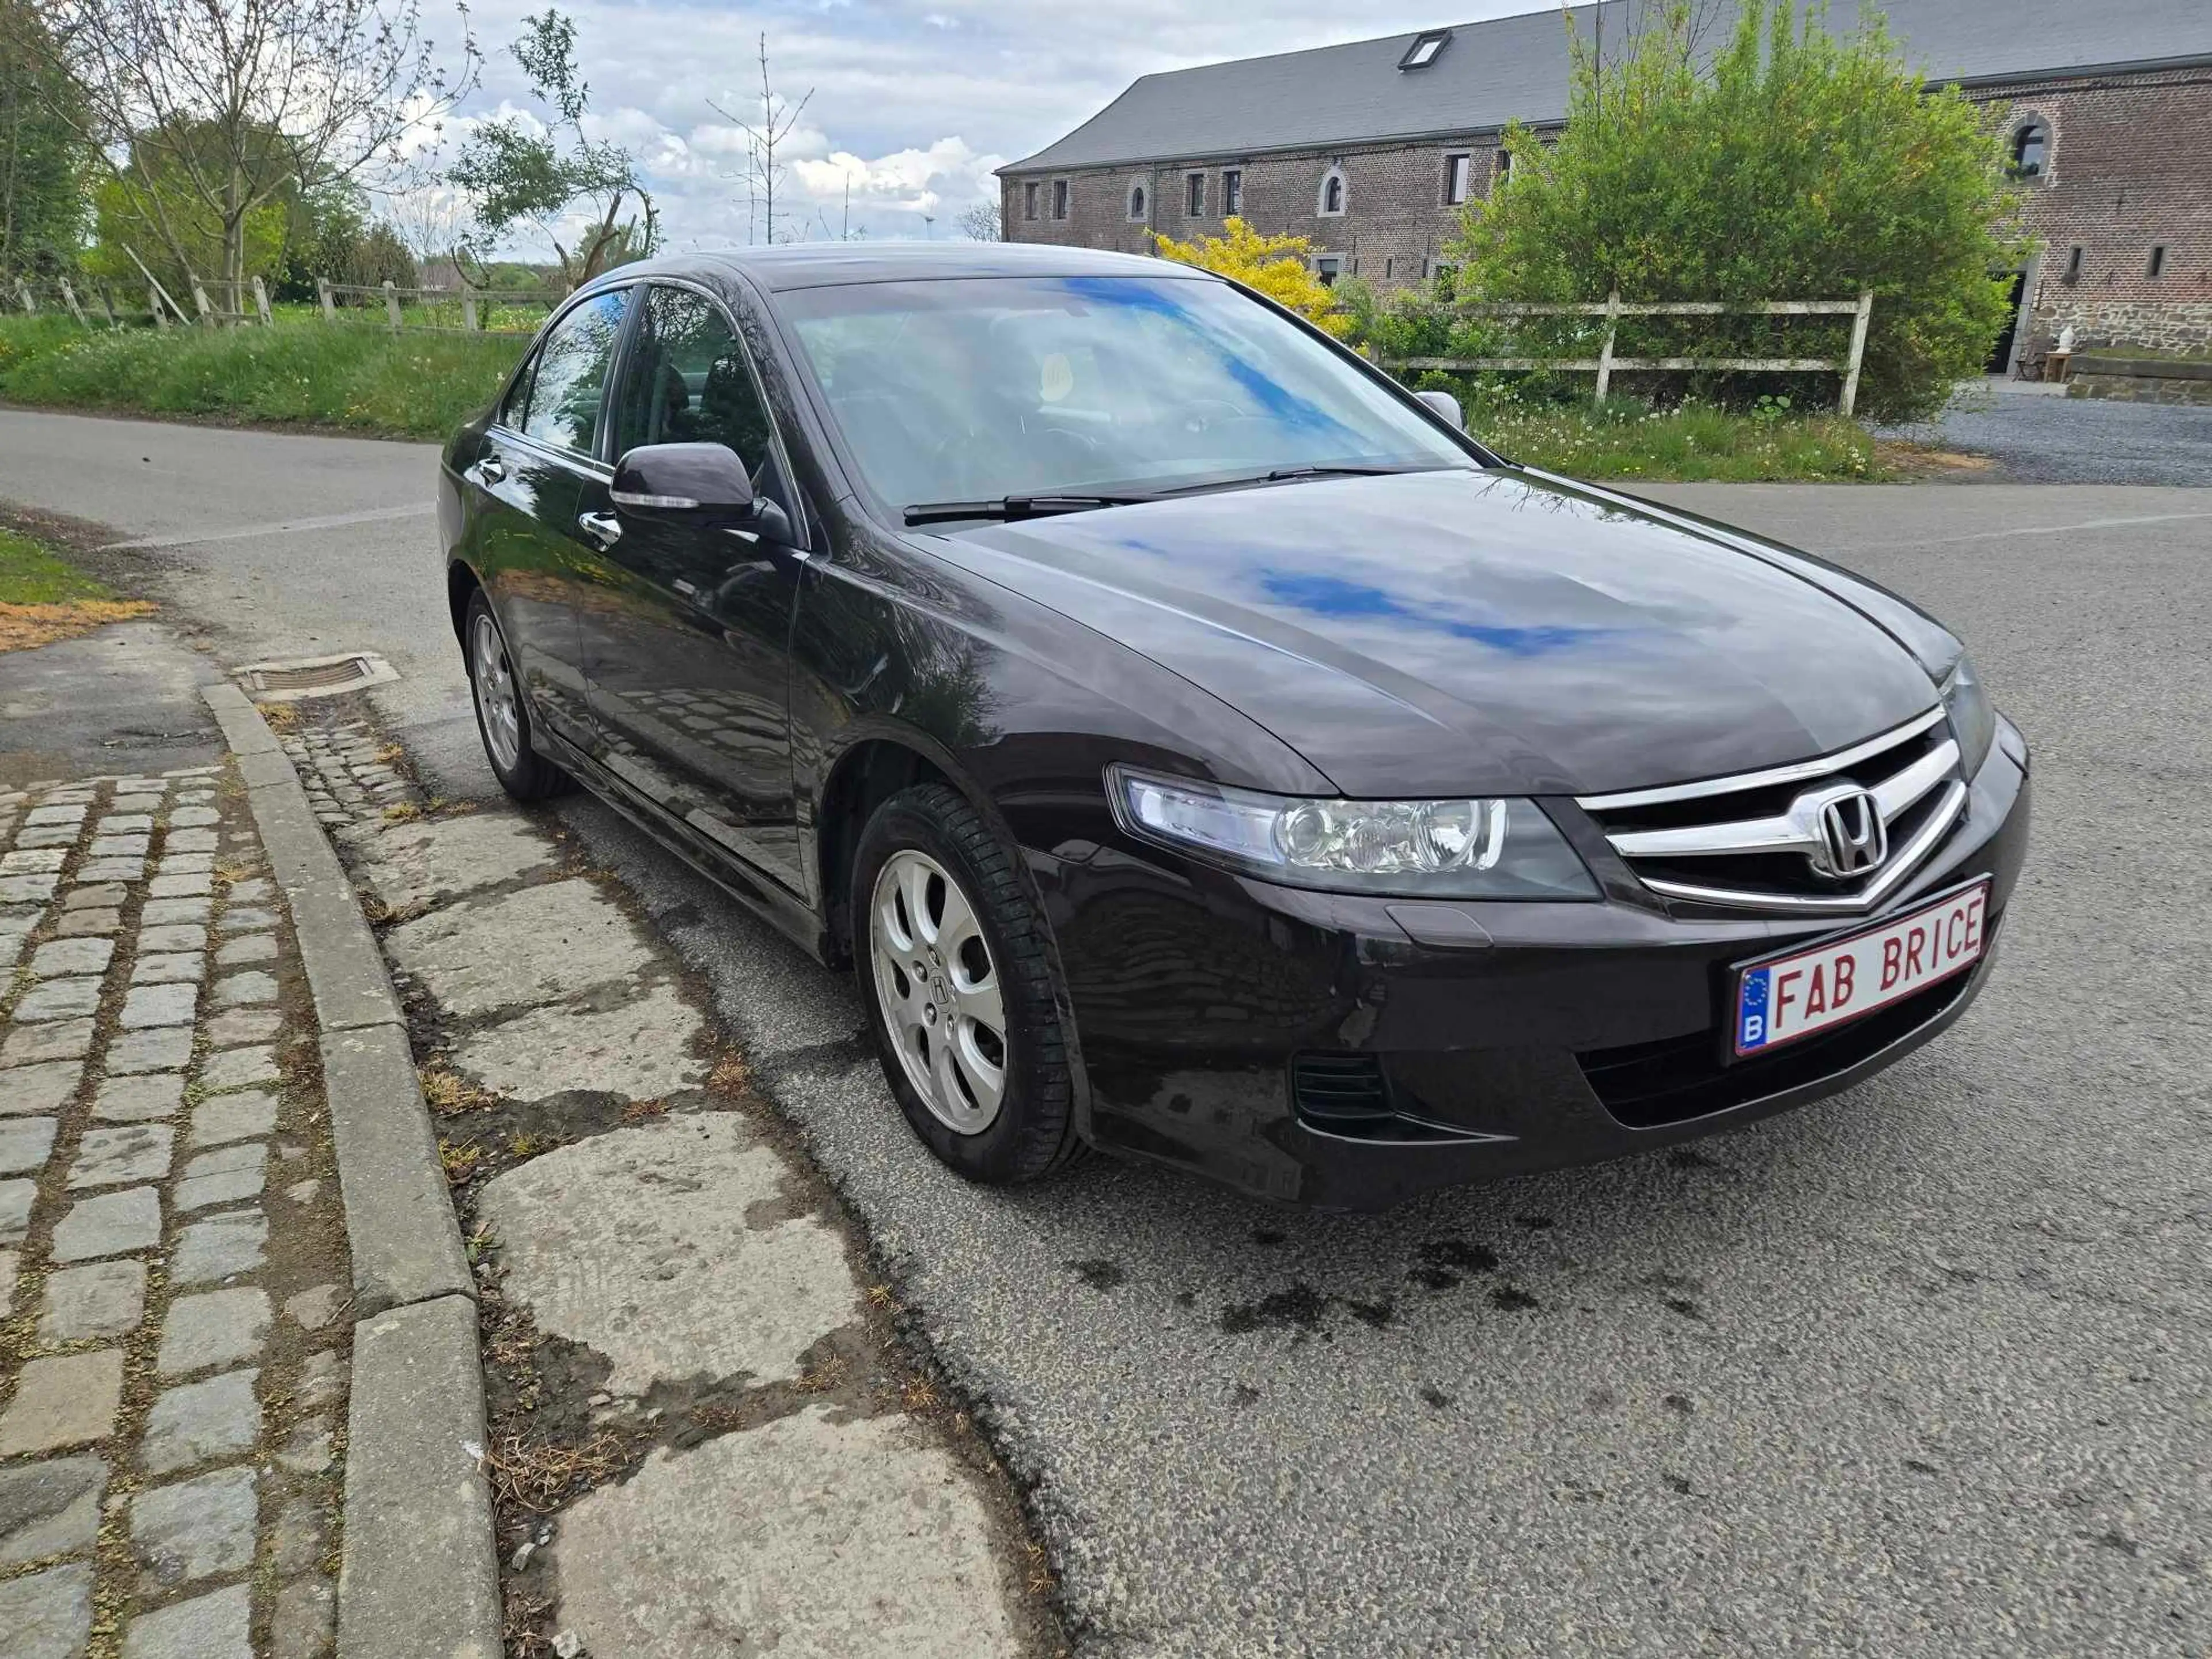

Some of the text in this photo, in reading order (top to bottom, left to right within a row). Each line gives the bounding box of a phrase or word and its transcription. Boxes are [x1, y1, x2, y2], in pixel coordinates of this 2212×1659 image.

[1775, 897, 1983, 1029] FAB BRICE
[1745, 1015, 1763, 1043] B
